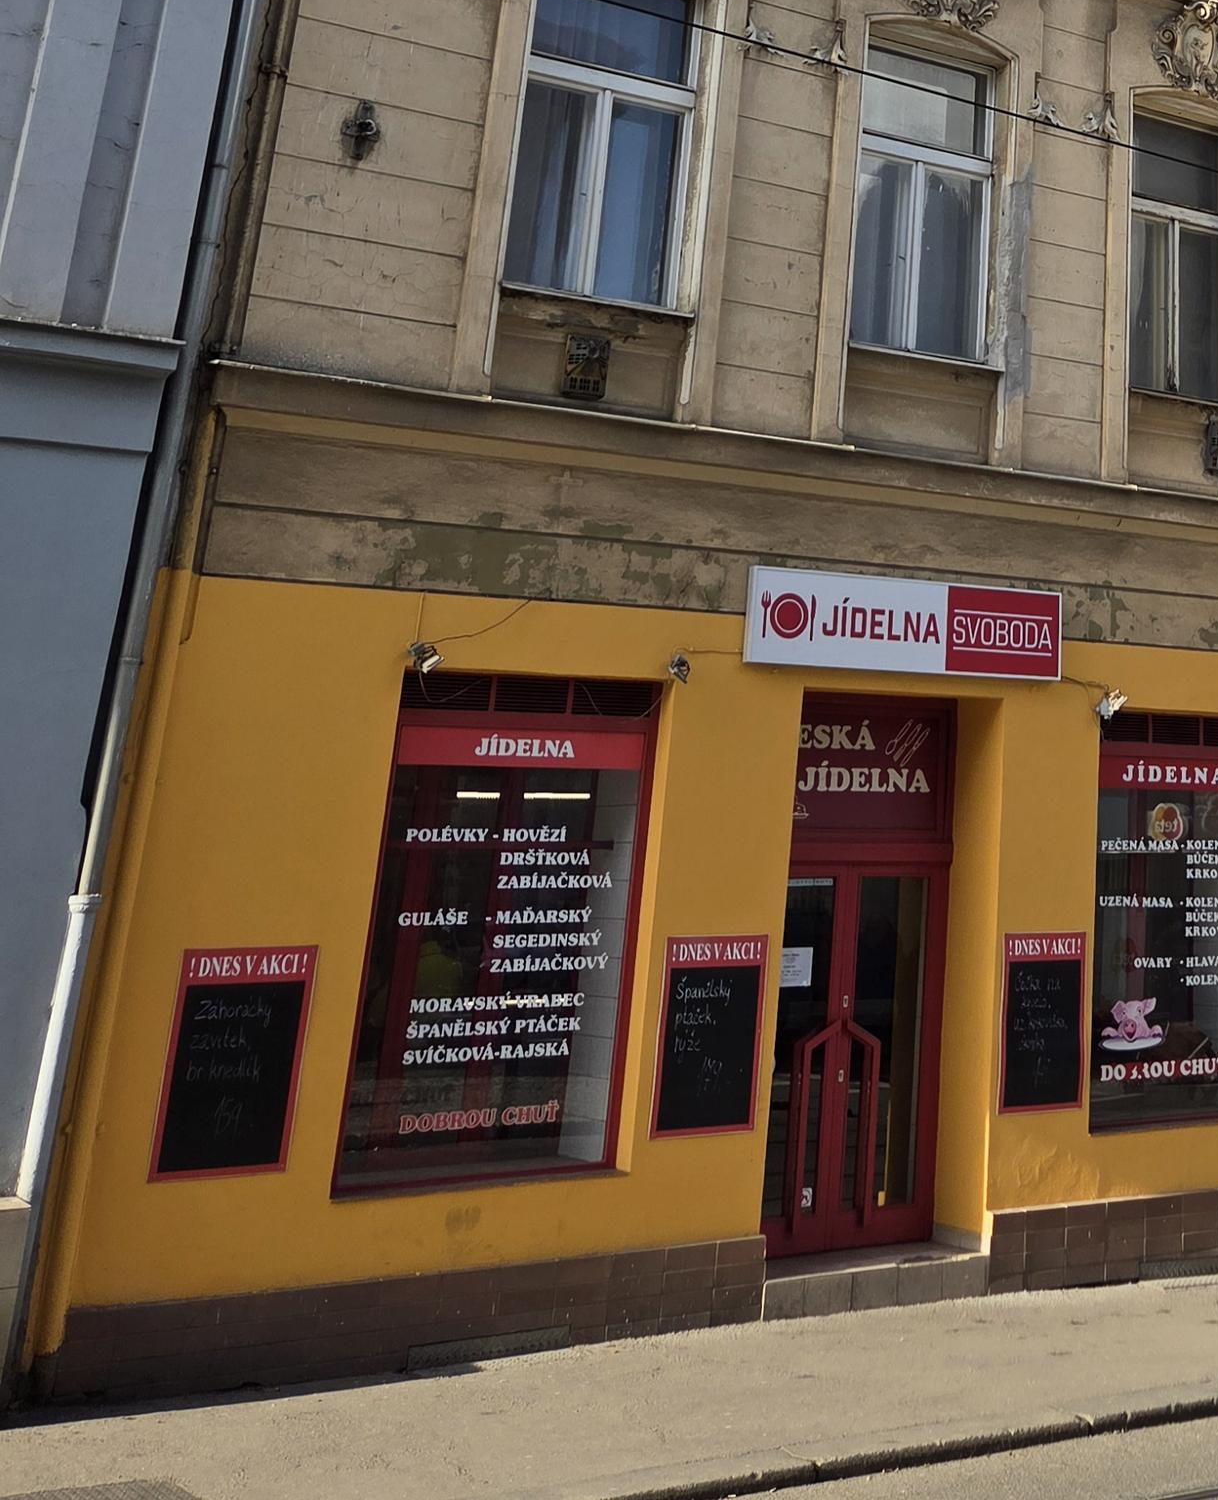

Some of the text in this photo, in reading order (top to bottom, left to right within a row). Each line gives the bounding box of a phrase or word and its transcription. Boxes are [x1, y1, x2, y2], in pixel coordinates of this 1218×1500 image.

[821, 597, 1052, 650] JÍDELNA SVOBODA
[474, 733, 575, 759] JÍDELNA
[799, 720, 876, 751] ESKÁ
[798, 760, 930, 793] JÍDELNA
[405, 825, 489, 843] POLÉVKY
[502, 825, 567, 843] HOVĚZÍ
[1101, 837, 1146, 851] PEČENÁ
[1148, 839, 1179, 852] MASA
[500, 849, 590, 866] DRŠŤKOVÁ
[496, 871, 613, 889] ZABÍJAČKOVÁ
[1099, 894, 1139, 907] UZENÁ
[1142, 897, 1173, 908] MASA
[398, 908, 469, 927] GULÁŠE
[495, 906, 592, 925] MAĎARSKÝ
[492, 929, 602, 949] SEGEDINSKÝ
[1015, 939, 1040, 955] DNES
[1042, 939, 1050, 955] V
[1050, 938, 1076, 955] AKCI
[679, 943, 711, 961] DNES
[714, 943, 723, 960] V
[723, 942, 755, 960] AKCI
[198, 956, 242, 977] DNES
[246, 955, 258, 975] V
[257, 954, 299, 975] AKCI
[489, 952, 609, 973] ZABÍJAČKOVÝ
[1134, 957, 1172, 968] OVARY
[409, 991, 585, 1014] MORAVSKÝ VRABEC
[406, 1016, 581, 1039] ŠPANĚLSKÝ PTÁČEK
[402, 1038, 569, 1066] SVÍČKOVÁ-RAJSKÁ
[399, 1100, 560, 1135] DOBROU CHUŤ
